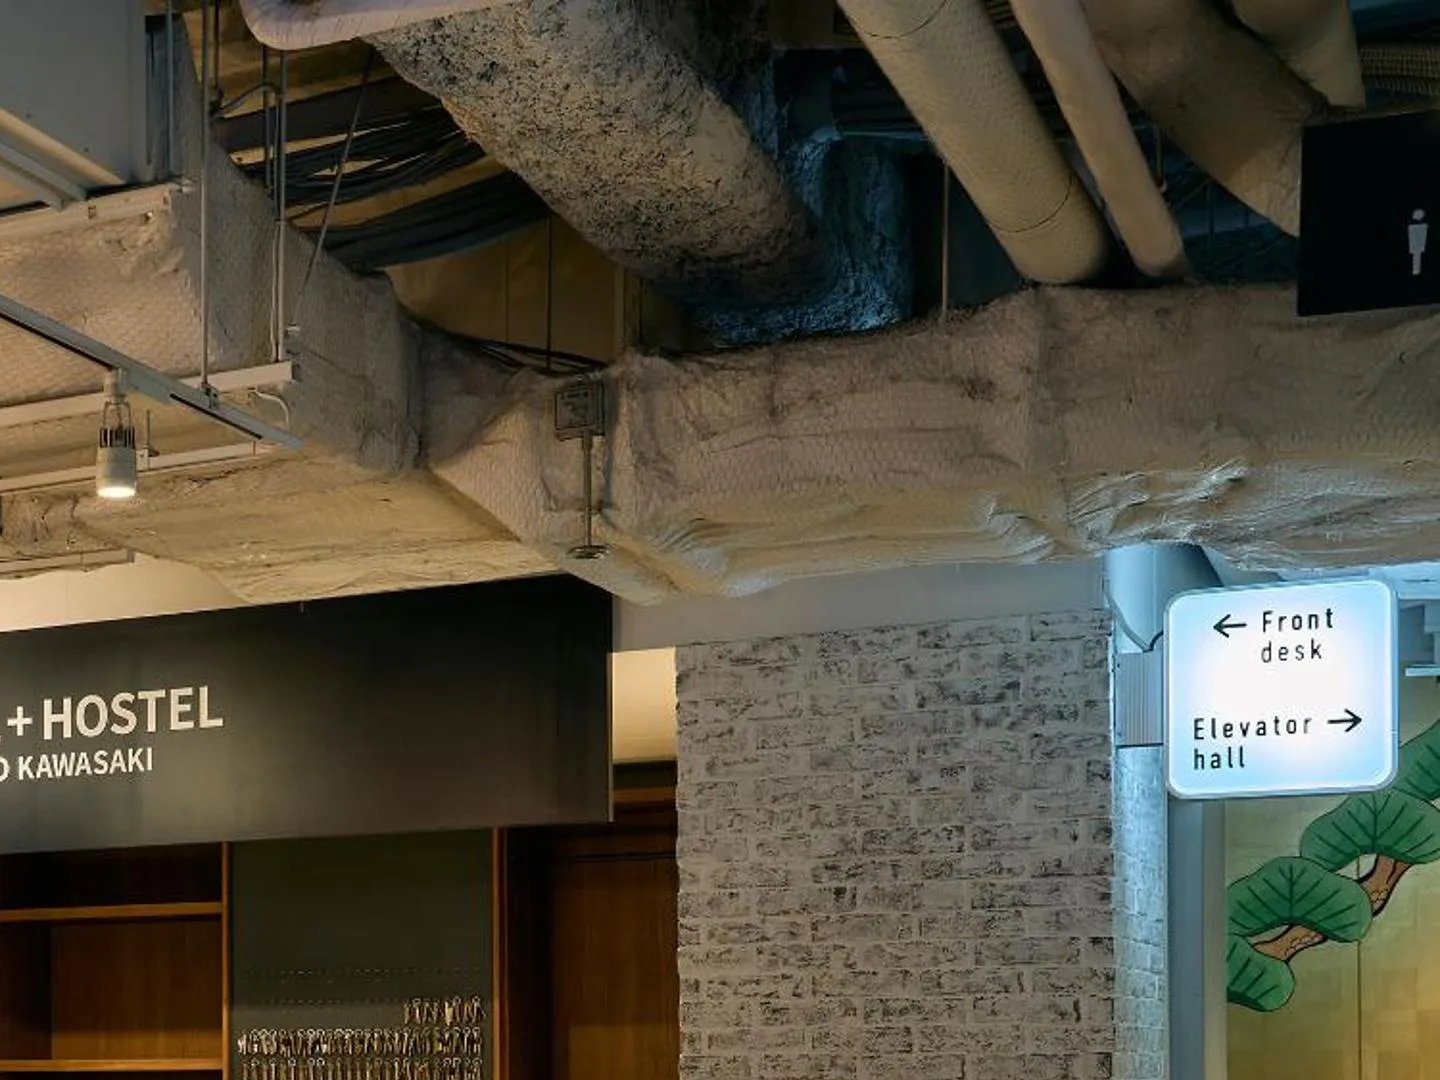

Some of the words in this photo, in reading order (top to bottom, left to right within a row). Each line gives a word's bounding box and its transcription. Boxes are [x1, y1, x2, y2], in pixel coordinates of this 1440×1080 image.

[1262, 607, 1334, 633] Front
[1260, 638, 1323, 663] desk
[42, 685, 224, 741] HOSTEL
[1193, 715, 1313, 741] Elevator
[18, 747, 153, 780] KAWASAKI
[1193, 745, 1245, 771] hall
